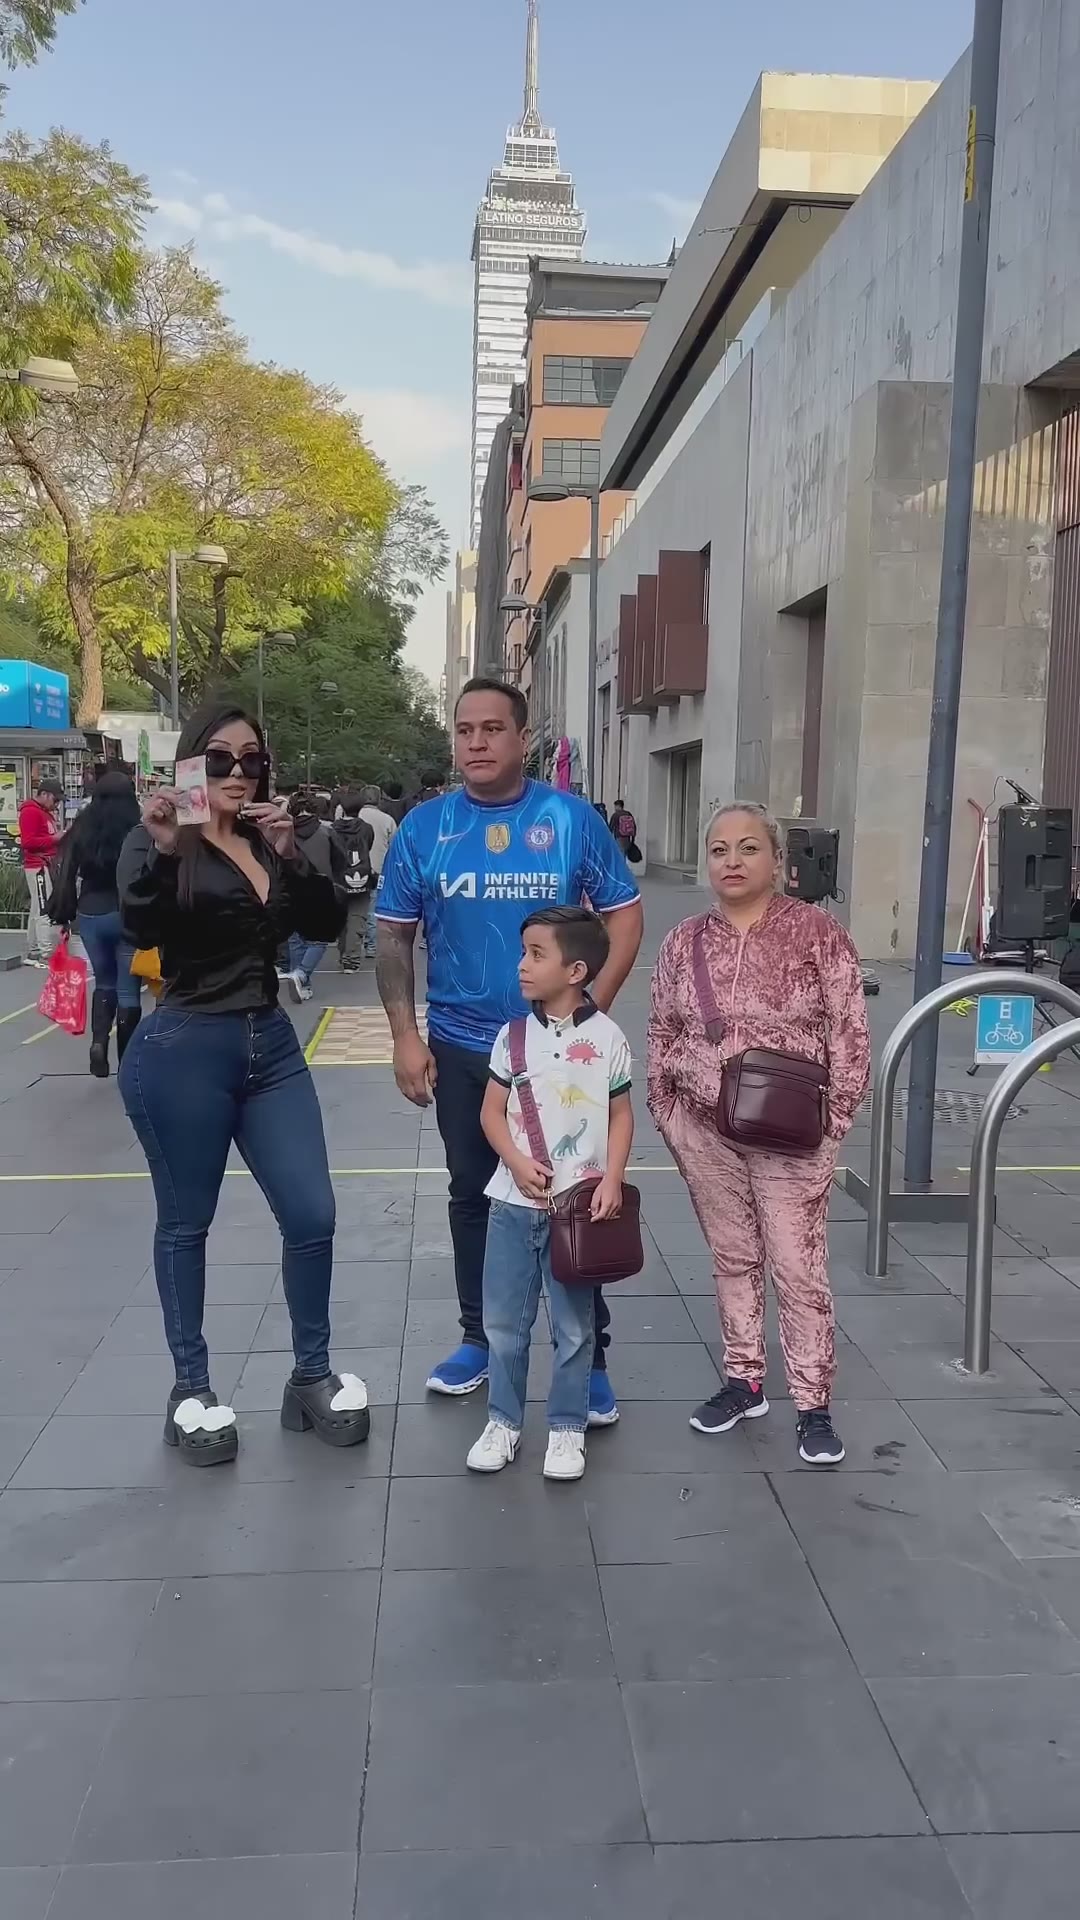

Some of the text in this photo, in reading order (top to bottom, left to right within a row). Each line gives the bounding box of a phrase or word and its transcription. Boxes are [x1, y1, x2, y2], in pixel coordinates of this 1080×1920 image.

[486, 212, 578, 227] LATINO SEGUROS
[484, 873, 558, 886] INFINITE
[483, 886, 557, 899] ATHLETE
